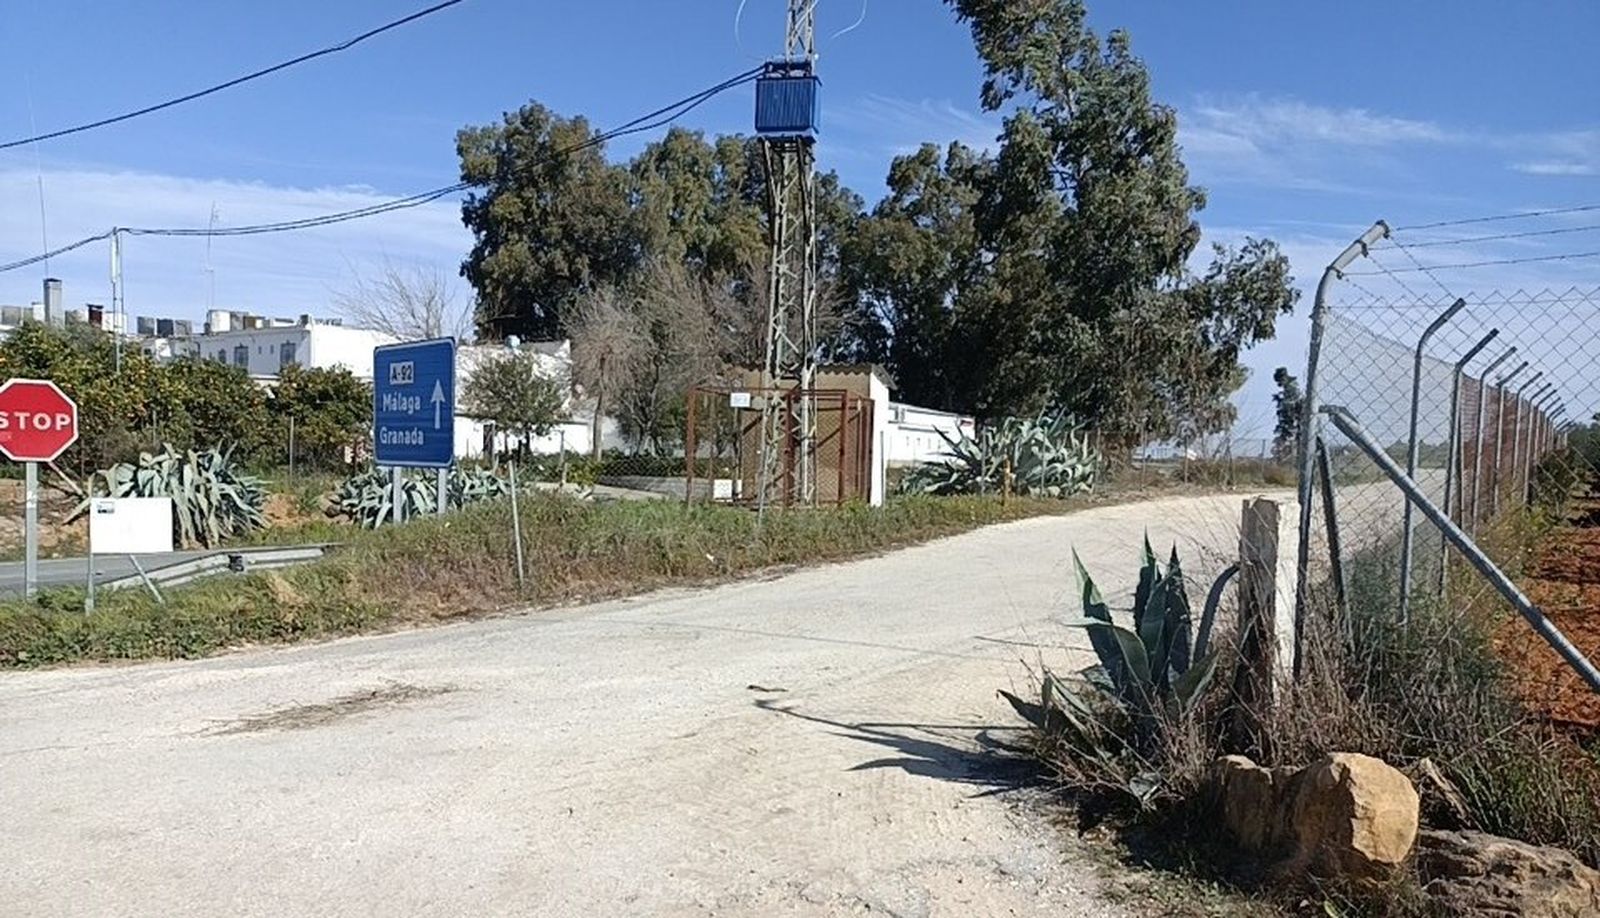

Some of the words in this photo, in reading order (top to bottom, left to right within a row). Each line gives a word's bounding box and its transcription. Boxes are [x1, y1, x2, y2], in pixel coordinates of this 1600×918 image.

[392, 365, 413, 381] A-92
[382, 392, 421, 414] Málaga
[0, 411, 71, 431] STOP
[379, 427, 424, 445] Granada
